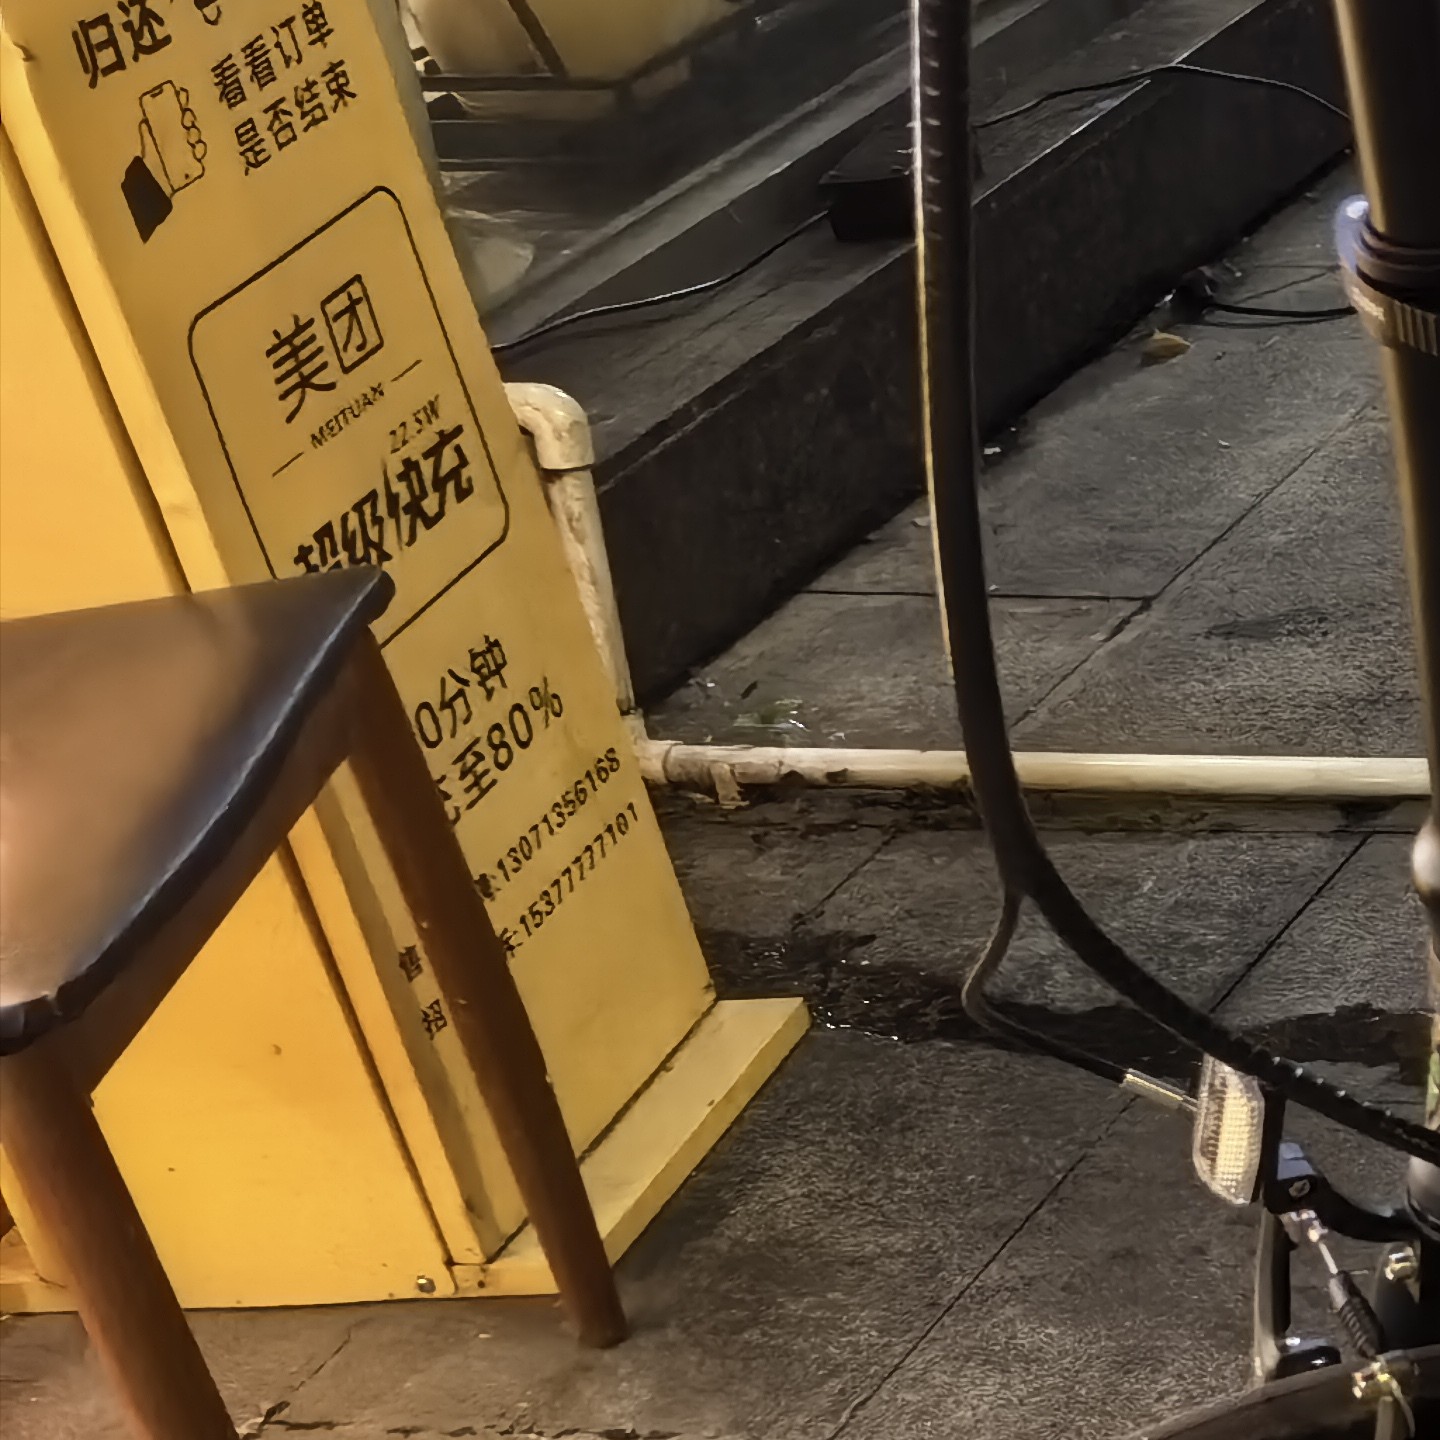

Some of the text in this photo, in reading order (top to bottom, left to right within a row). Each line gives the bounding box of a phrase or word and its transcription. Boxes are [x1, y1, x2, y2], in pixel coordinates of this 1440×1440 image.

[234, 58, 358, 177] 是否结束
[265, 273, 385, 425] 美团
[309, 381, 386, 449] MEITUAN
